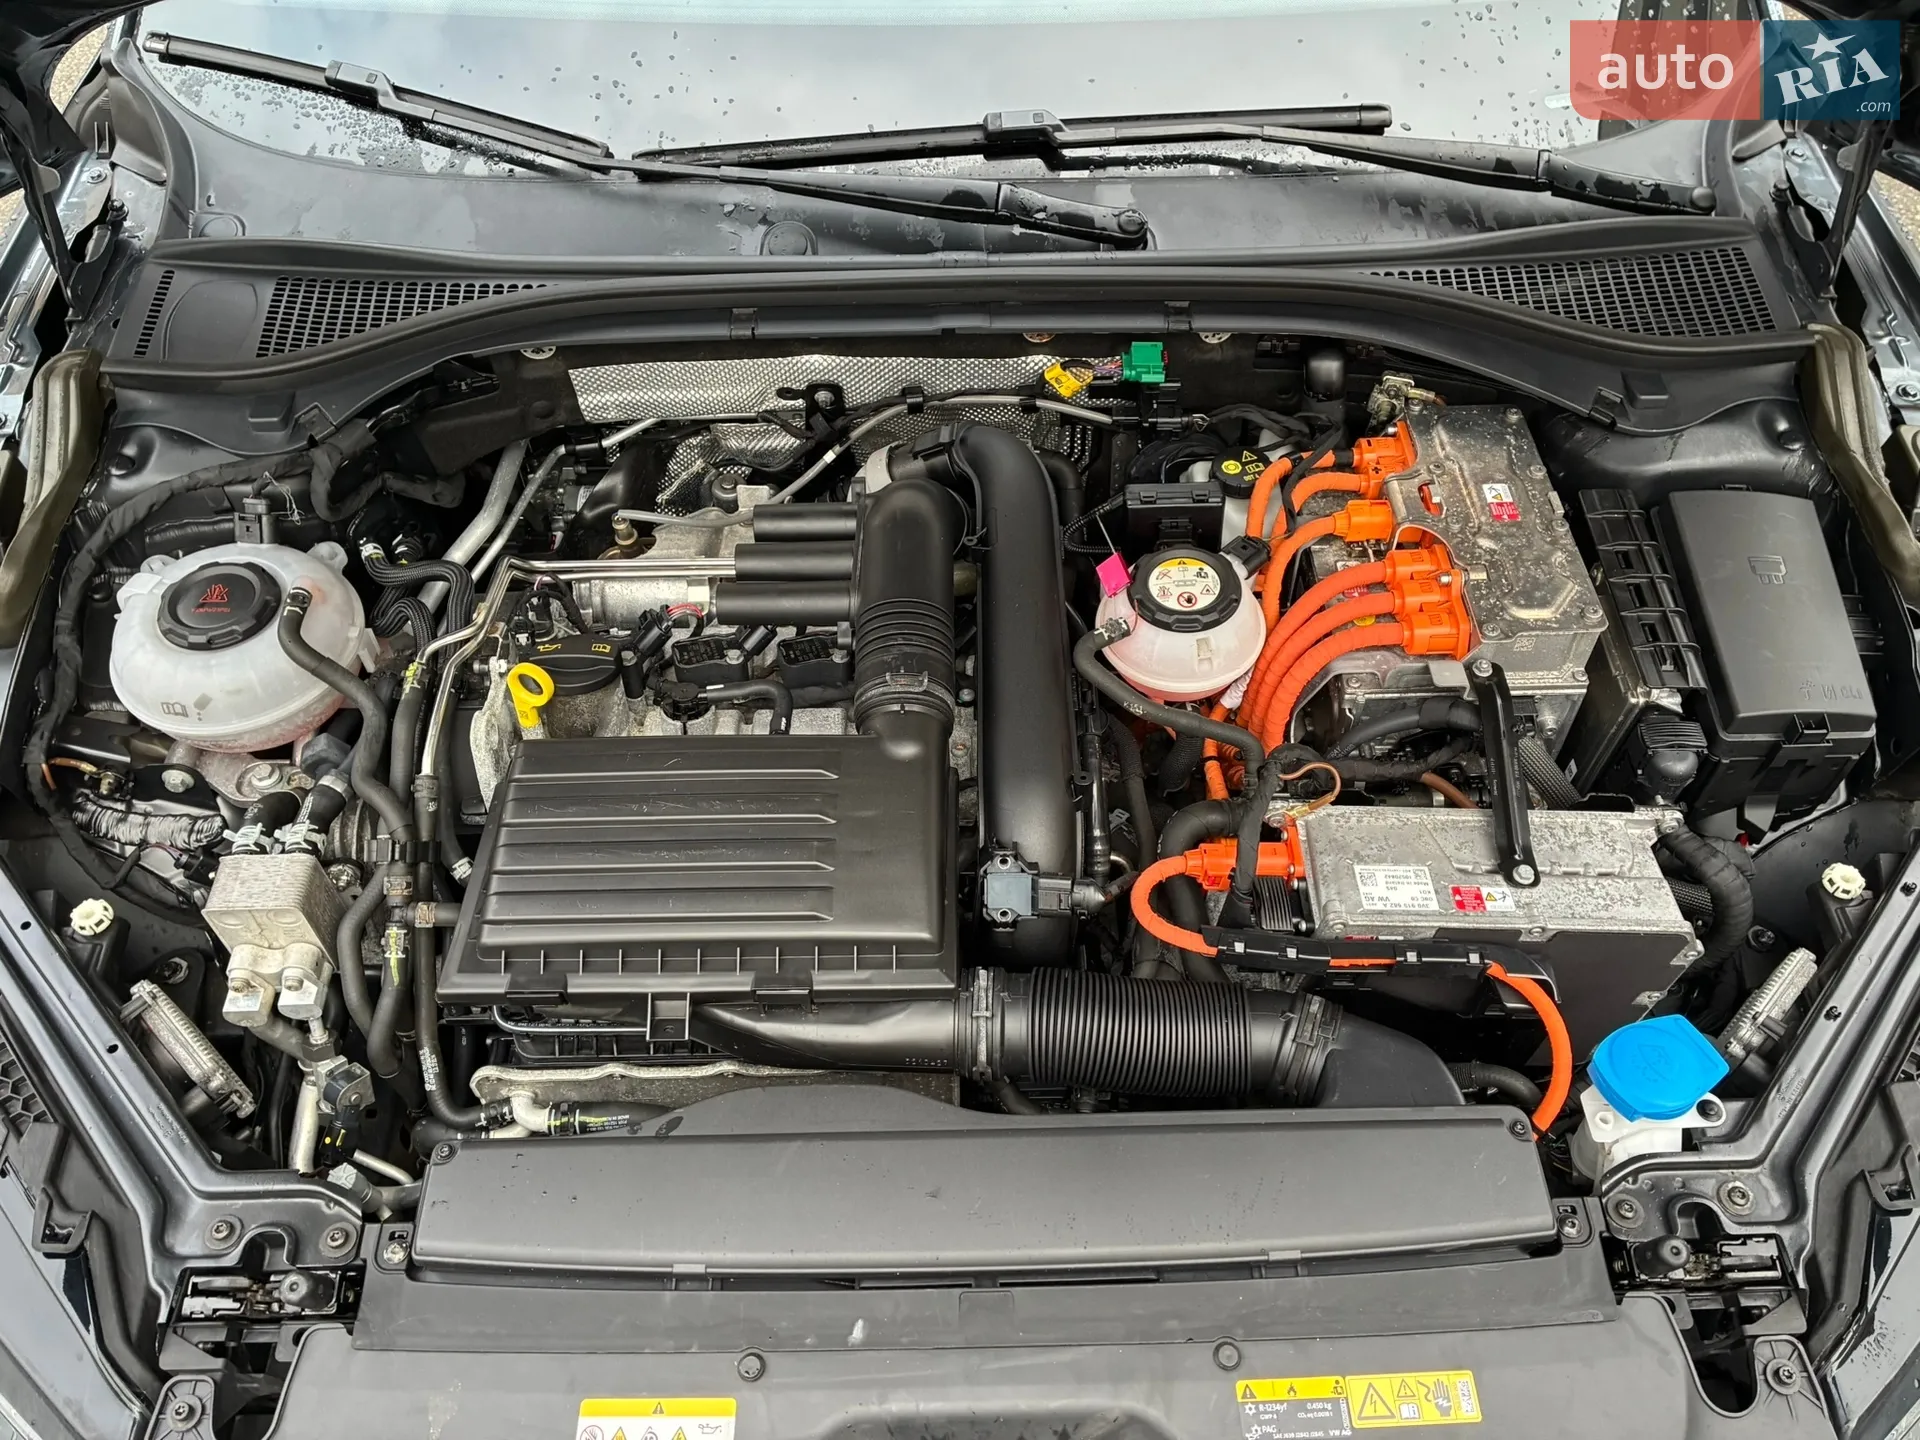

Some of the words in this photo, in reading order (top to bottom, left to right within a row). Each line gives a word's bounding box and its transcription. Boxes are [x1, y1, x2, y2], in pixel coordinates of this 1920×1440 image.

[1258, 1402, 1288, 1413] R-1234yf
[1261, 1425, 1277, 1434] PAG
[1328, 1429, 1340, 1437] VW
